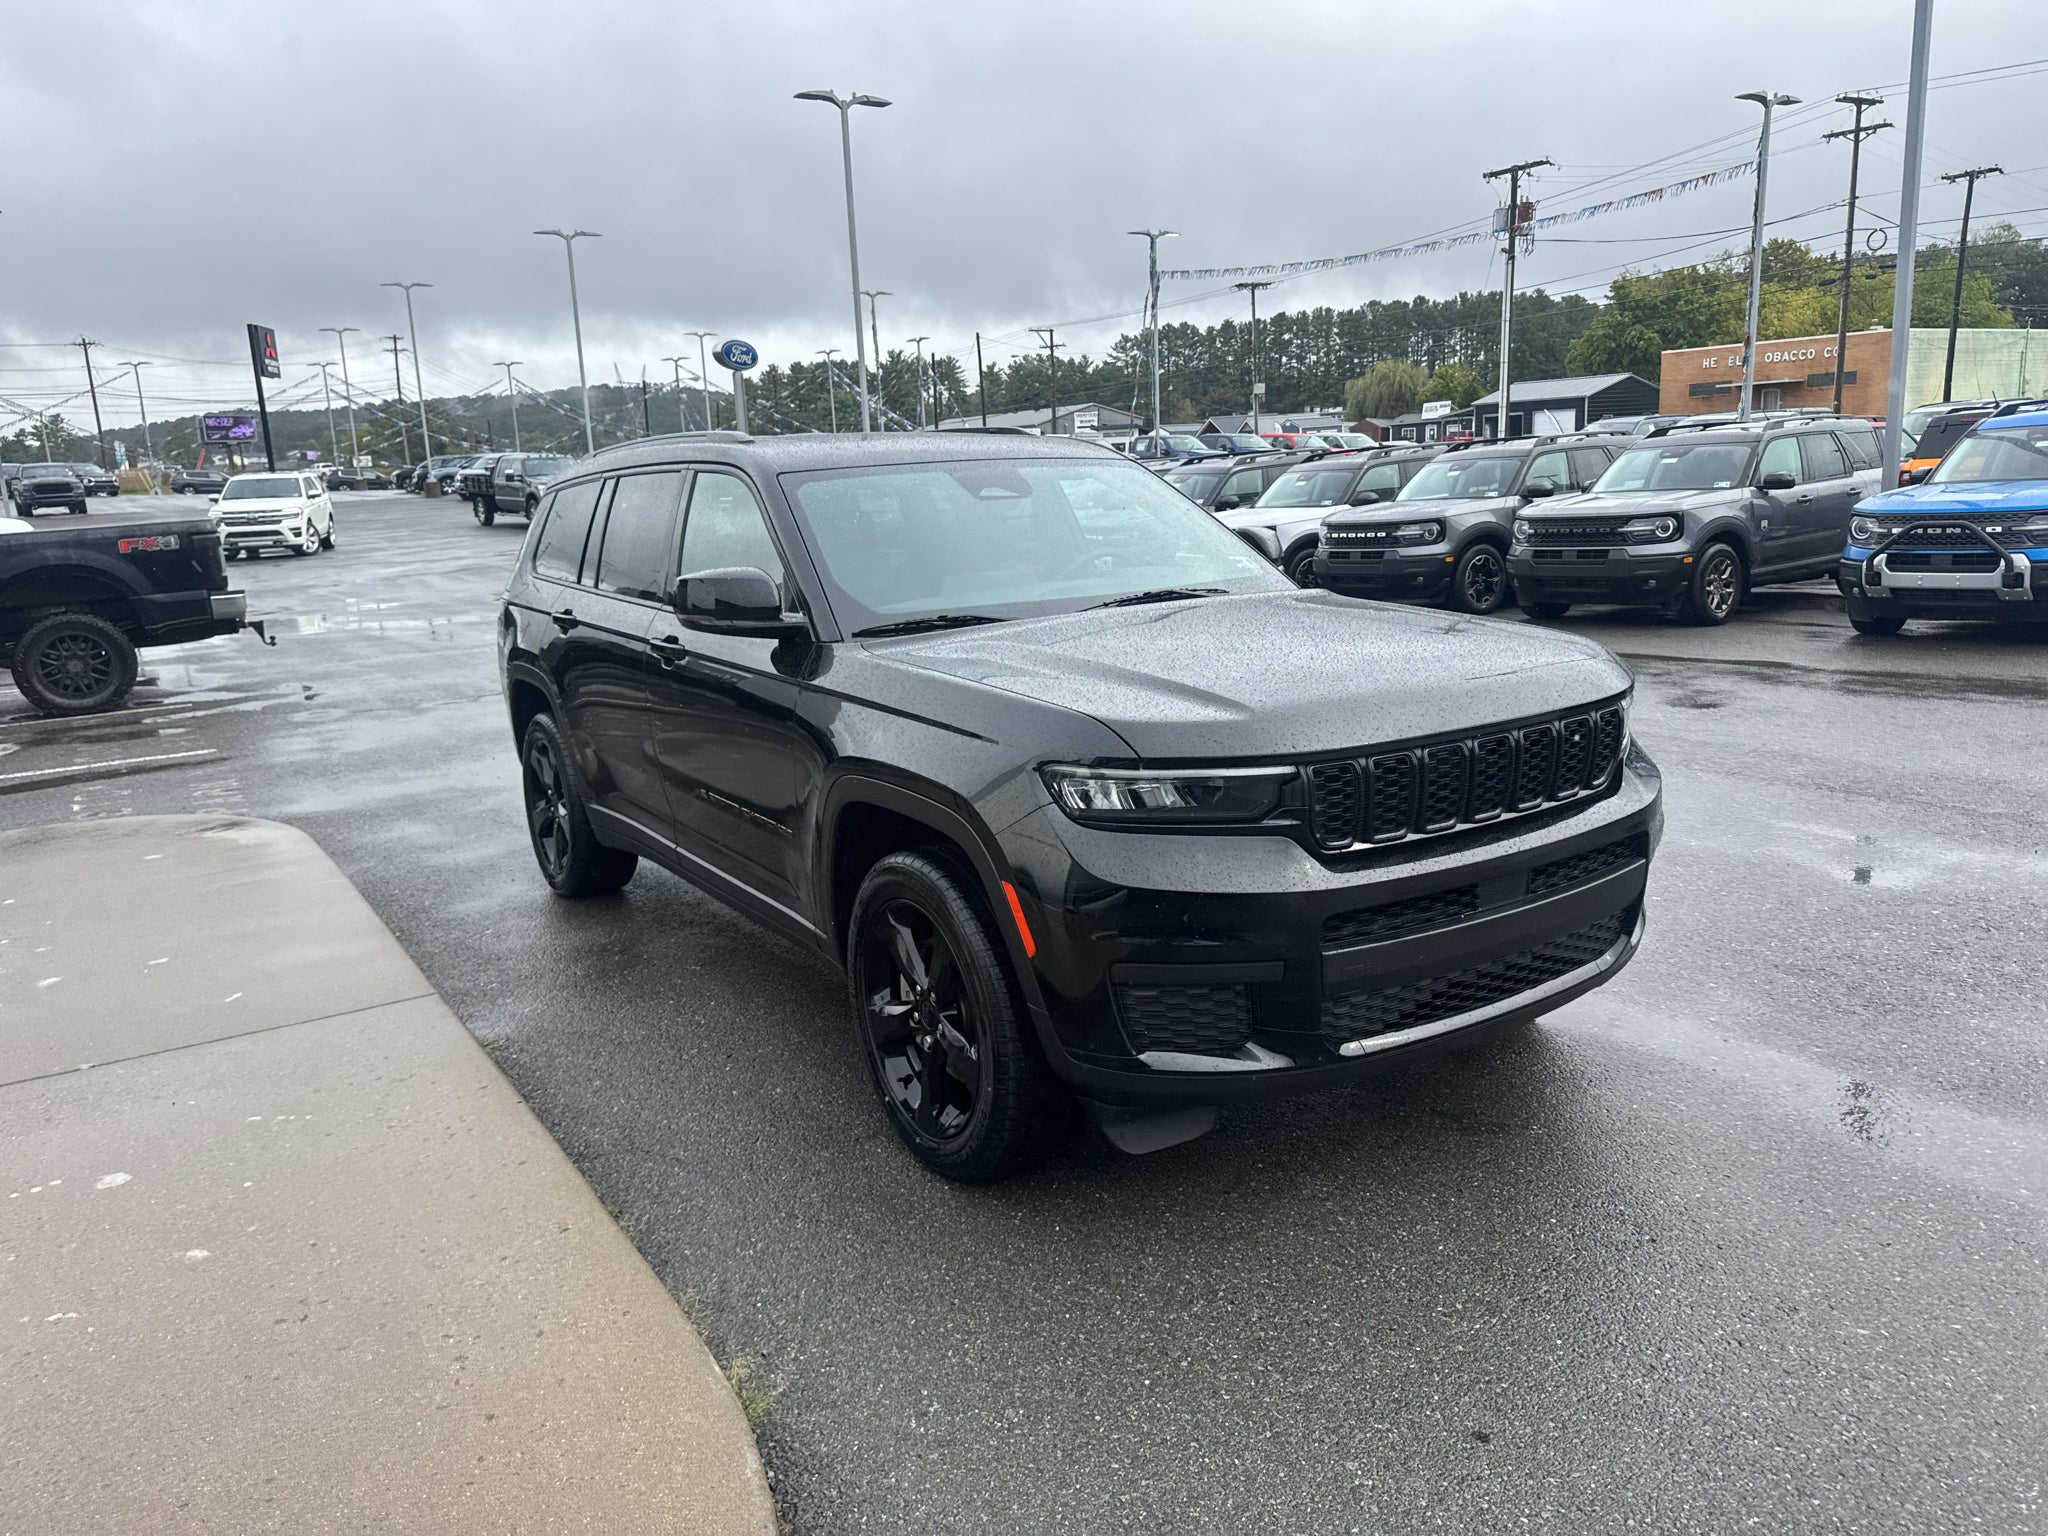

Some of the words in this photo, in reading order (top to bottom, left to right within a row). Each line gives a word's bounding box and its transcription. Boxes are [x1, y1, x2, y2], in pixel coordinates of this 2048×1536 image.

[730, 344, 753, 365] Ford
[1764, 348, 1816, 362] OBACCO
[117, 534, 180, 554] FX4
